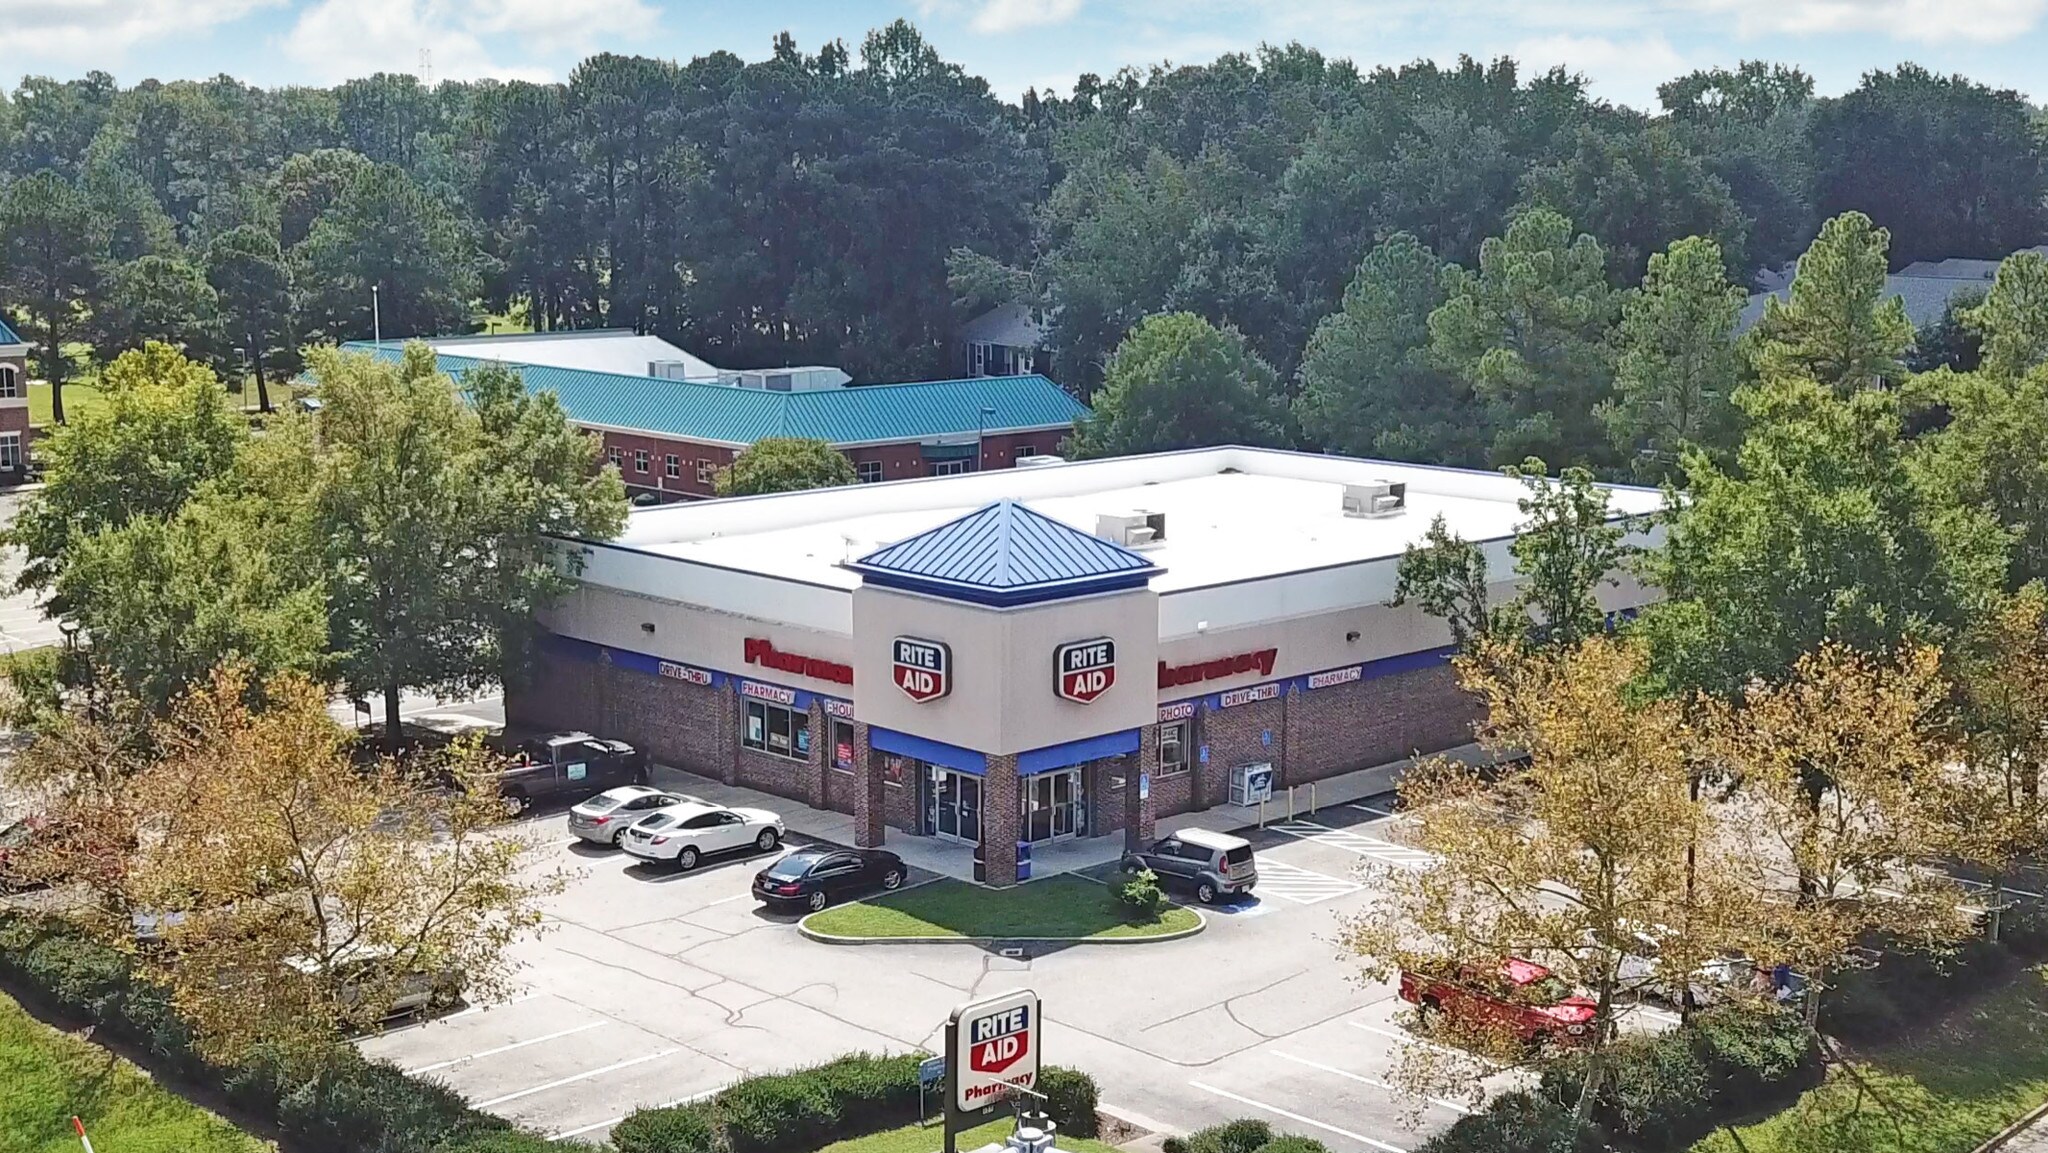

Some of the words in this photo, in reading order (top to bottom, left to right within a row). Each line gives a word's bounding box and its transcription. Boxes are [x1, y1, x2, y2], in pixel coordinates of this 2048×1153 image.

[900, 643, 935, 667] RITE
[1071, 645, 1108, 669] RITE
[660, 663, 708, 685] DRIVE-THRU
[902, 669, 934, 694] AID
[1073, 671, 1106, 696] AID
[1312, 667, 1362, 688] PHARMACY
[742, 682, 792, 703] PHARMACY
[1224, 684, 1280, 706] DRIVE-THRU
[1160, 705, 1194, 721] PHOTO
[977, 1008, 1023, 1041] RITE
[981, 1036, 1019, 1067] AID
